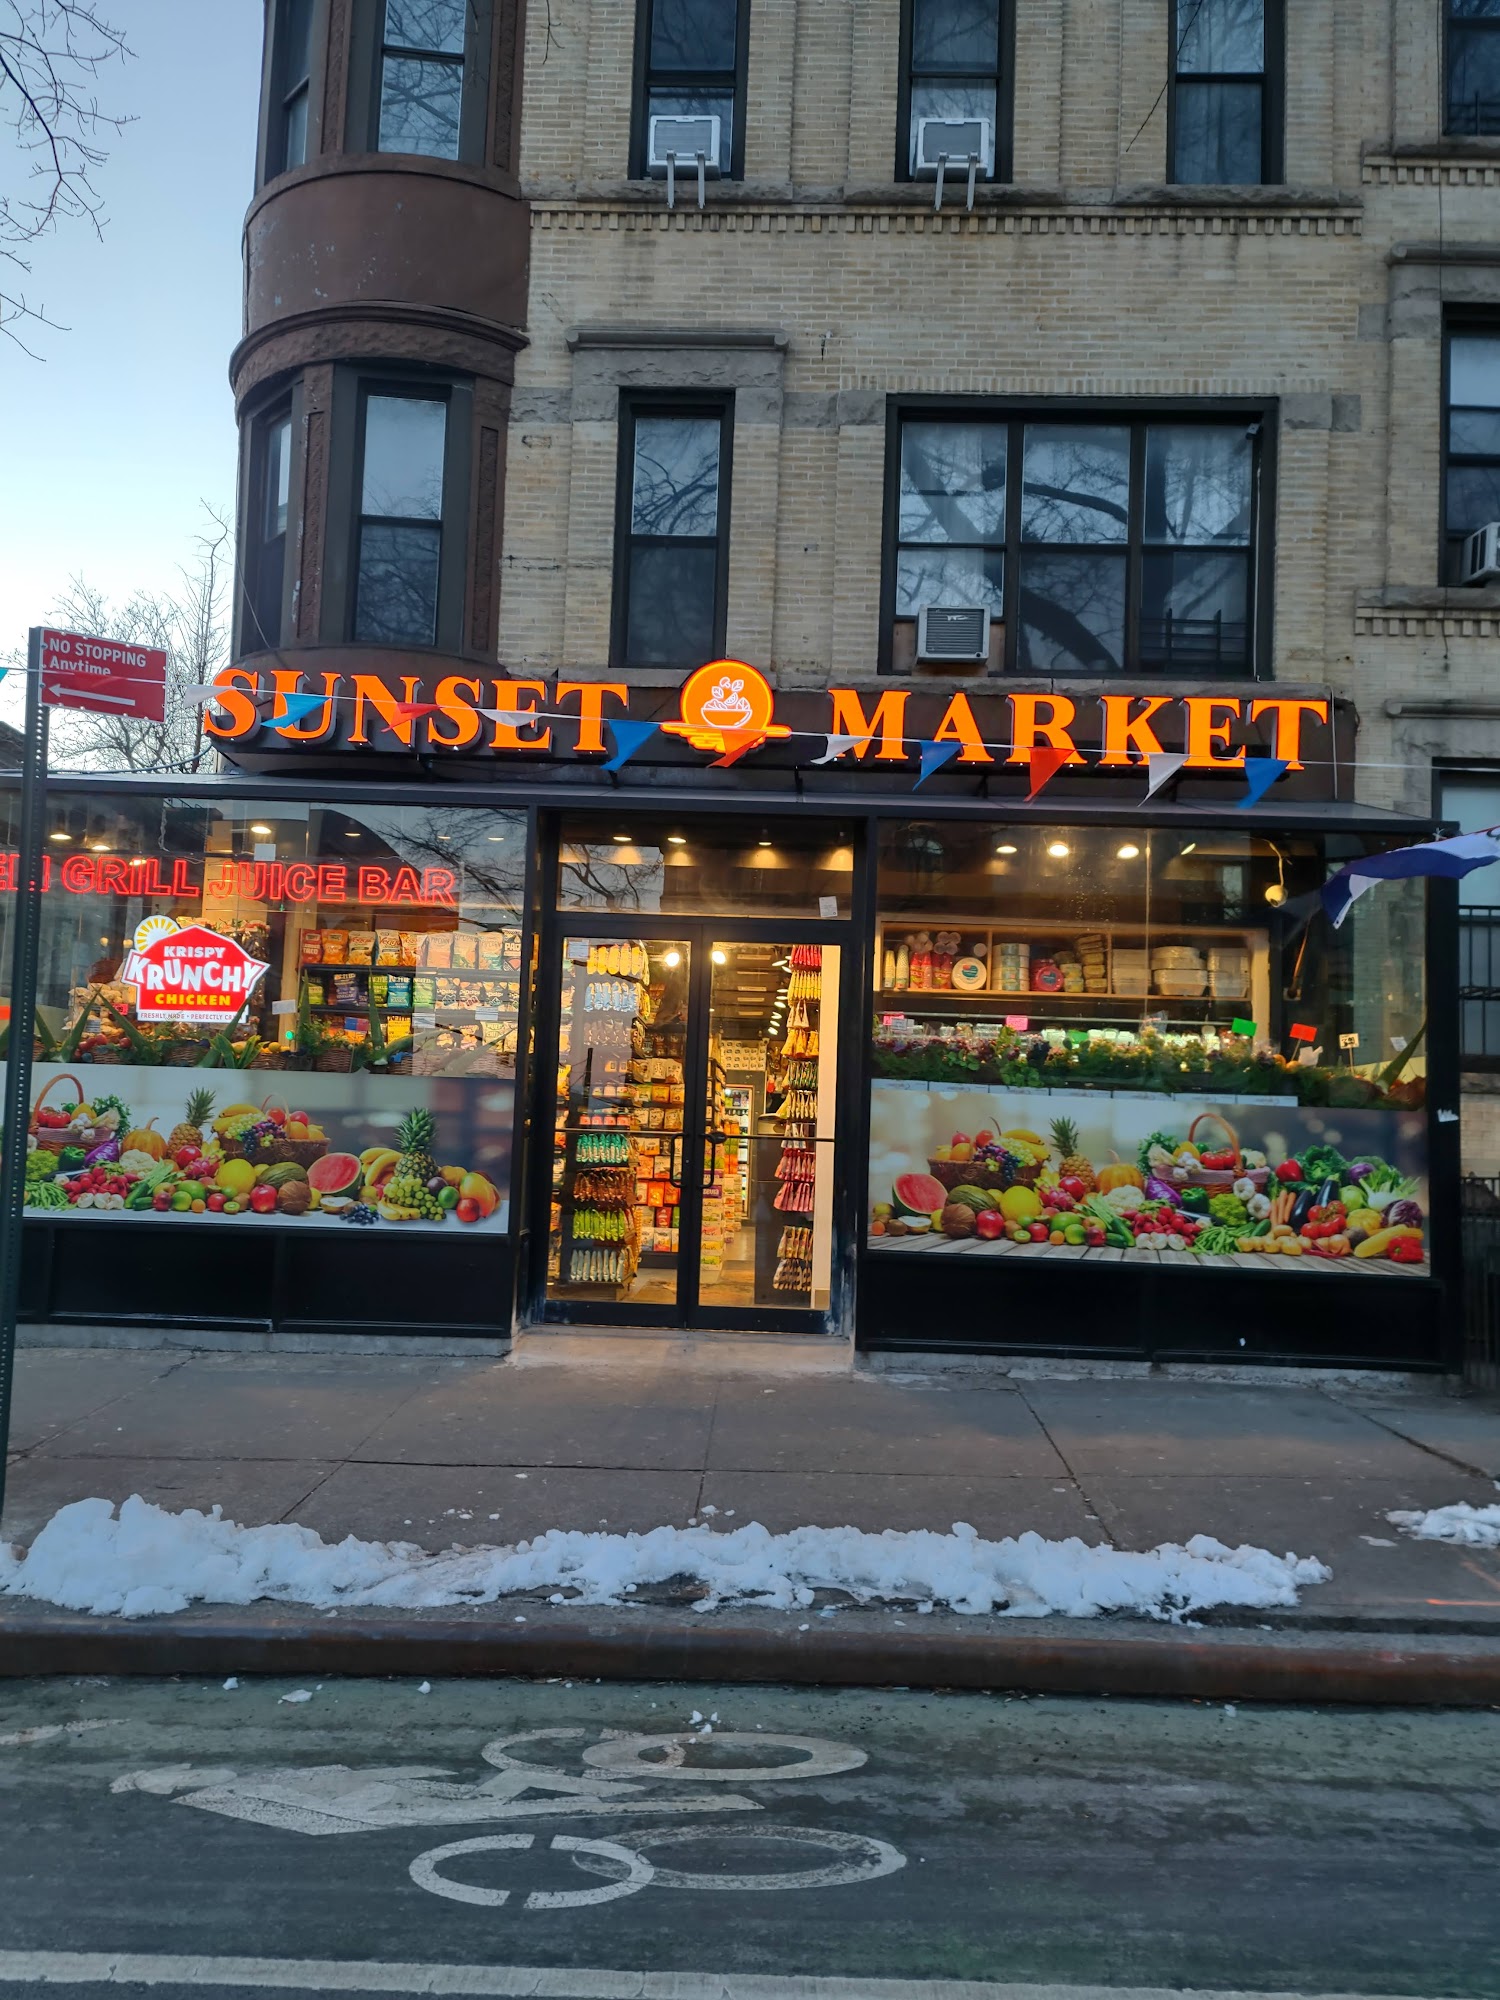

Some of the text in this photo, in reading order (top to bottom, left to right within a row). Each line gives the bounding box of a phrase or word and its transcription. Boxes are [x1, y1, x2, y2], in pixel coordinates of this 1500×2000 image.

[49, 638, 147, 668] NO STOPPING
[50, 655, 111, 675] Anytime
[205, 668, 1328, 771] SUNSET MARKET
[61, 855, 200, 897] GRILL
[208, 861, 347, 902] JUICE
[357, 865, 457, 906] BAR
[164, 945, 226, 958] KRISPY
[127, 955, 262, 992] KRUNCHY
[155, 993, 231, 1006] CHICKEN
